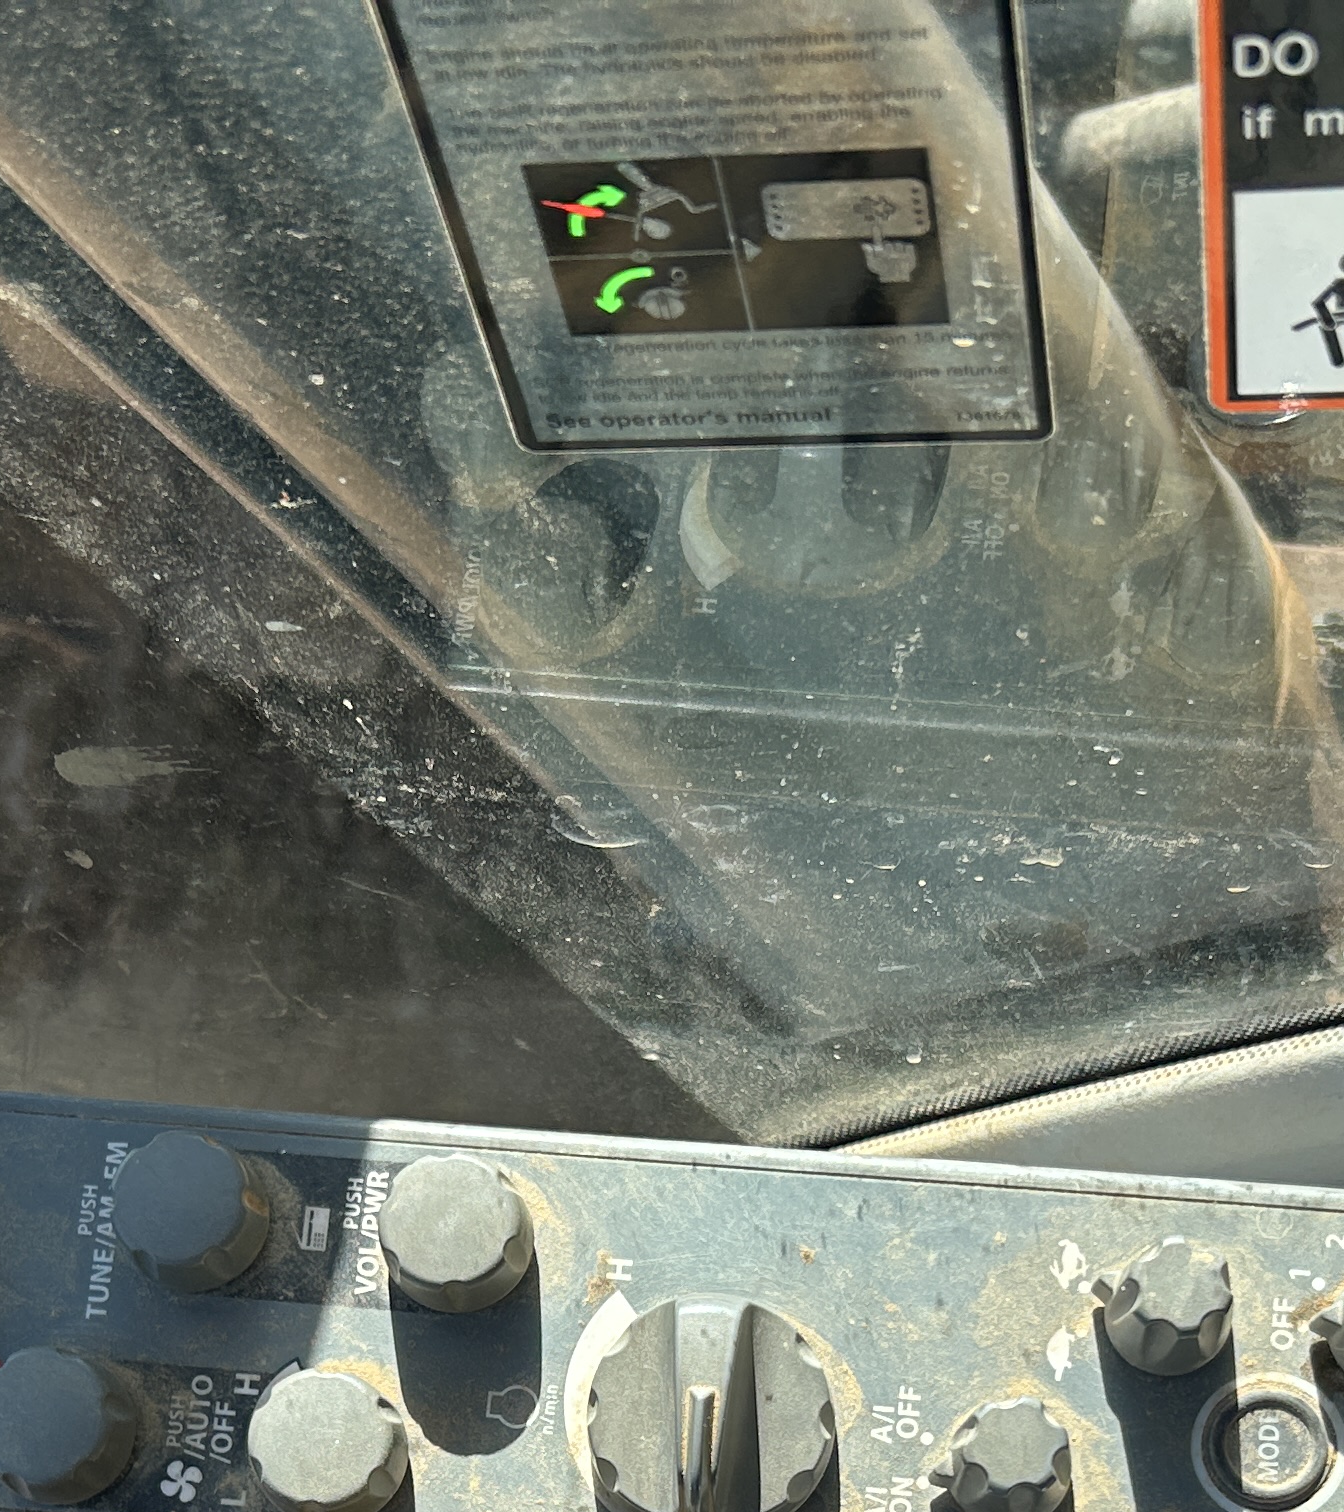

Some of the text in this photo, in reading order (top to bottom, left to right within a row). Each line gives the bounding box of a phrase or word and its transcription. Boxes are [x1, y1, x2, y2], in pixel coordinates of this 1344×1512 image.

[1233, 30, 1319, 79] DO
[1241, 105, 1278, 141] if
[545, 411, 592, 430] See
[599, 408, 729, 431] operator's
[736, 405, 832, 425] manual
[77, 1184, 99, 1237] PUSH
[343, 1177, 364, 1230] PUSH
[353, 1171, 390, 1295] VOL/PWR
[605, 1258, 634, 1281] H
[1288, 1268, 1311, 1280] 1
[1269, 1296, 1296, 1351] OFF
[233, 1372, 262, 1396] H
[539, 1384, 559, 1435] n/min
[165, 1395, 186, 1448] PUSH
[183, 1374, 214, 1461] /AUTO
[208, 1400, 237, 1465] /OFF
[870, 1405, 895, 1444] A/I
[895, 1385, 922, 1439] OFF
[220, 1489, 247, 1507] L
